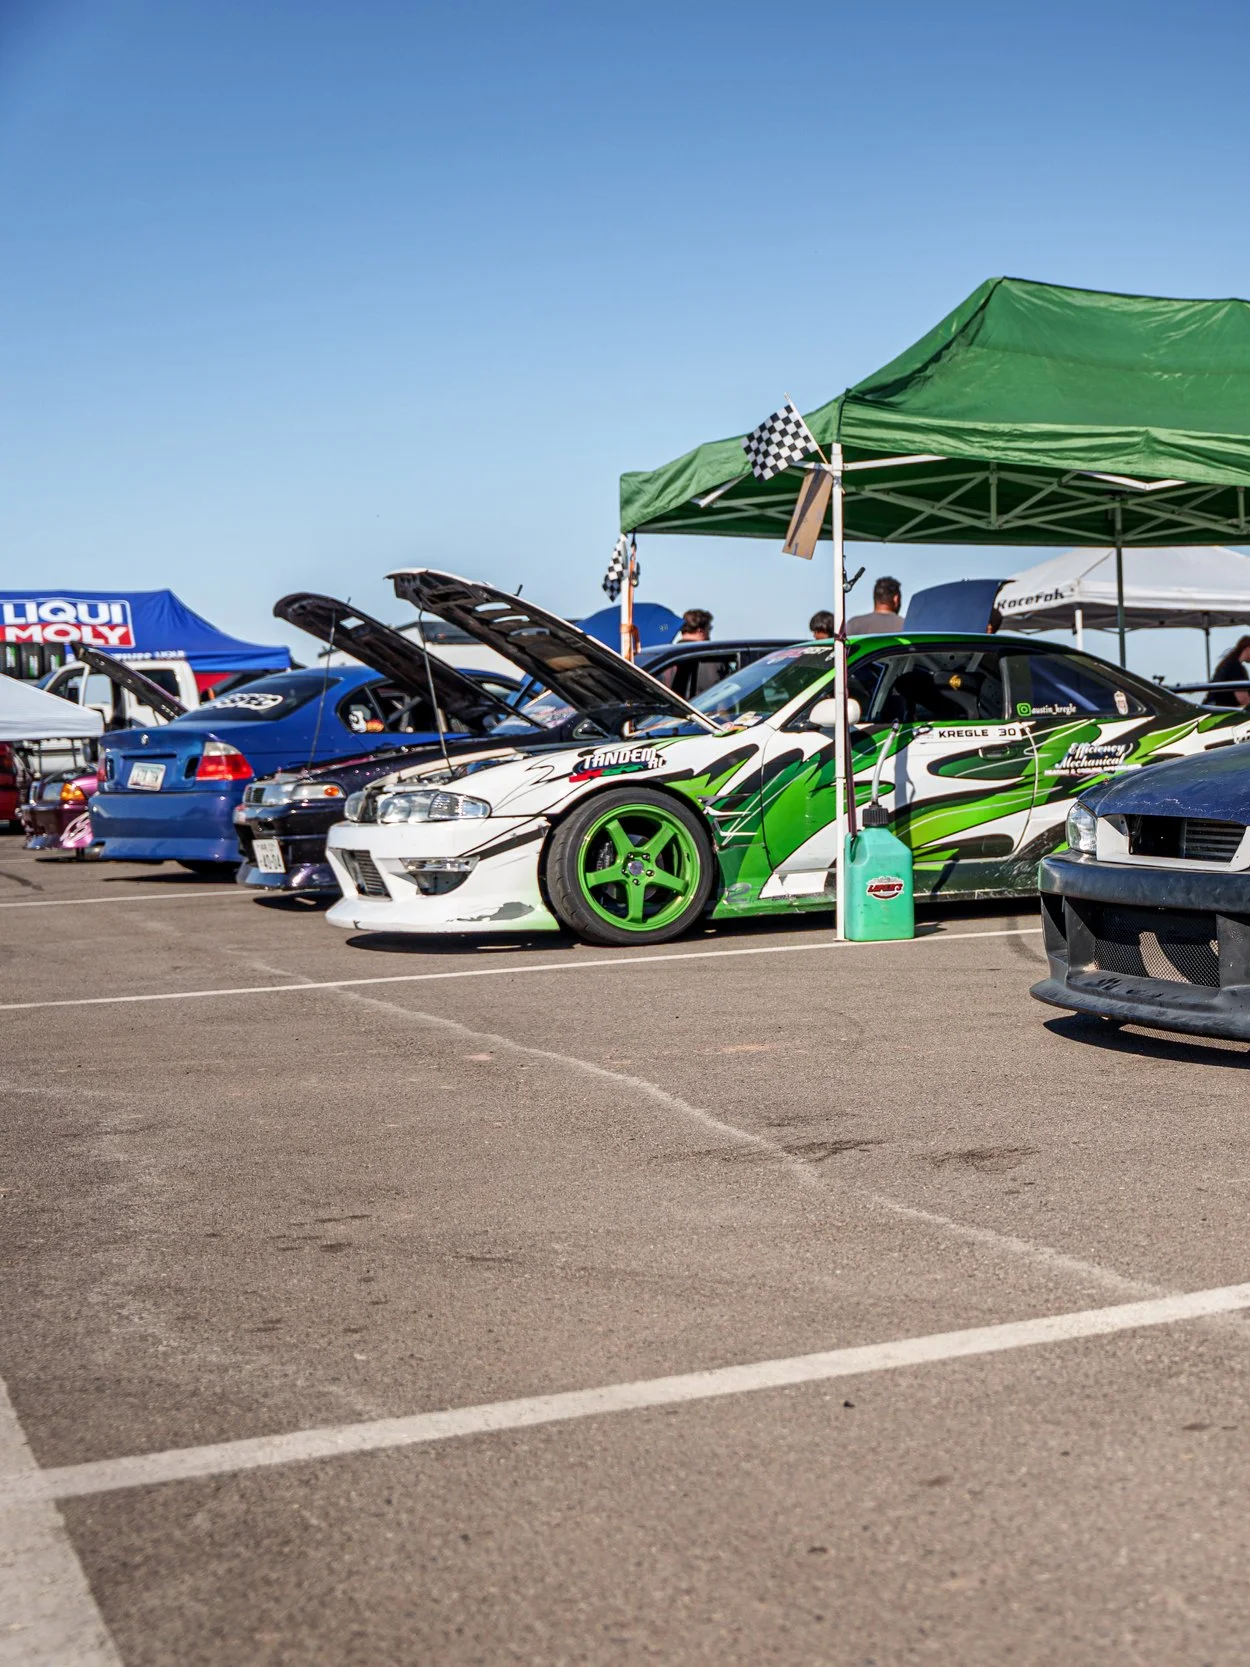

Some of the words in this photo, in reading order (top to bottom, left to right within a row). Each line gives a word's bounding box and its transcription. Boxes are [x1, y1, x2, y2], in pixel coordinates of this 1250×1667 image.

[2, 600, 124, 625] LIQUI
[5, 622, 128, 646] MOLY
[938, 728, 989, 738] KREGLE
[998, 728, 1016, 737] 30
[584, 748, 657, 769] TANDEM
[1068, 742, 1127, 758] Efficiency
[1055, 753, 1126, 768] Mechanical
